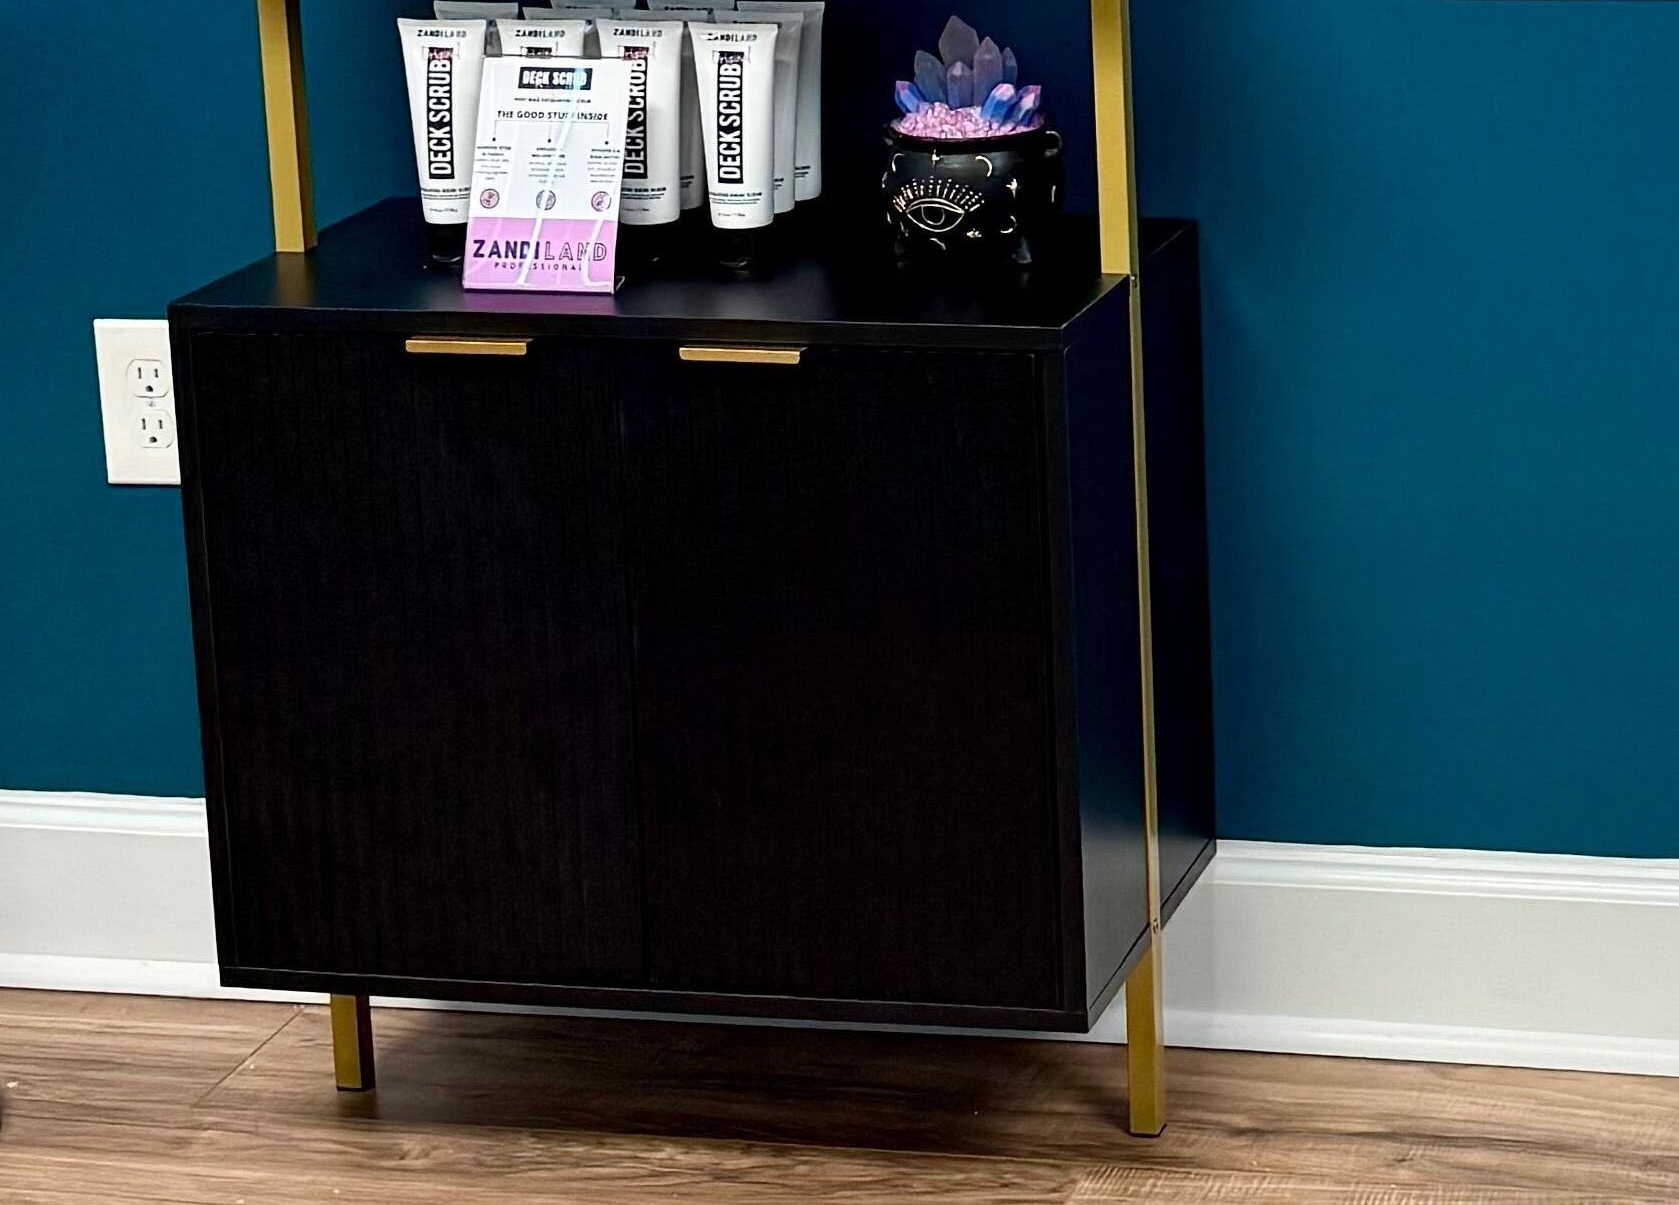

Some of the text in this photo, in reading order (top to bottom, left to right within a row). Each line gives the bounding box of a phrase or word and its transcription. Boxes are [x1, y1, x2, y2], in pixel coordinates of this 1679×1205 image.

[522, 71, 550, 85] DECK
[428, 59, 452, 174] DECK SCRUB
[497, 110, 513, 118] THE
[517, 111, 544, 119] GOOD
[718, 63, 741, 179] DECK SCRUB
